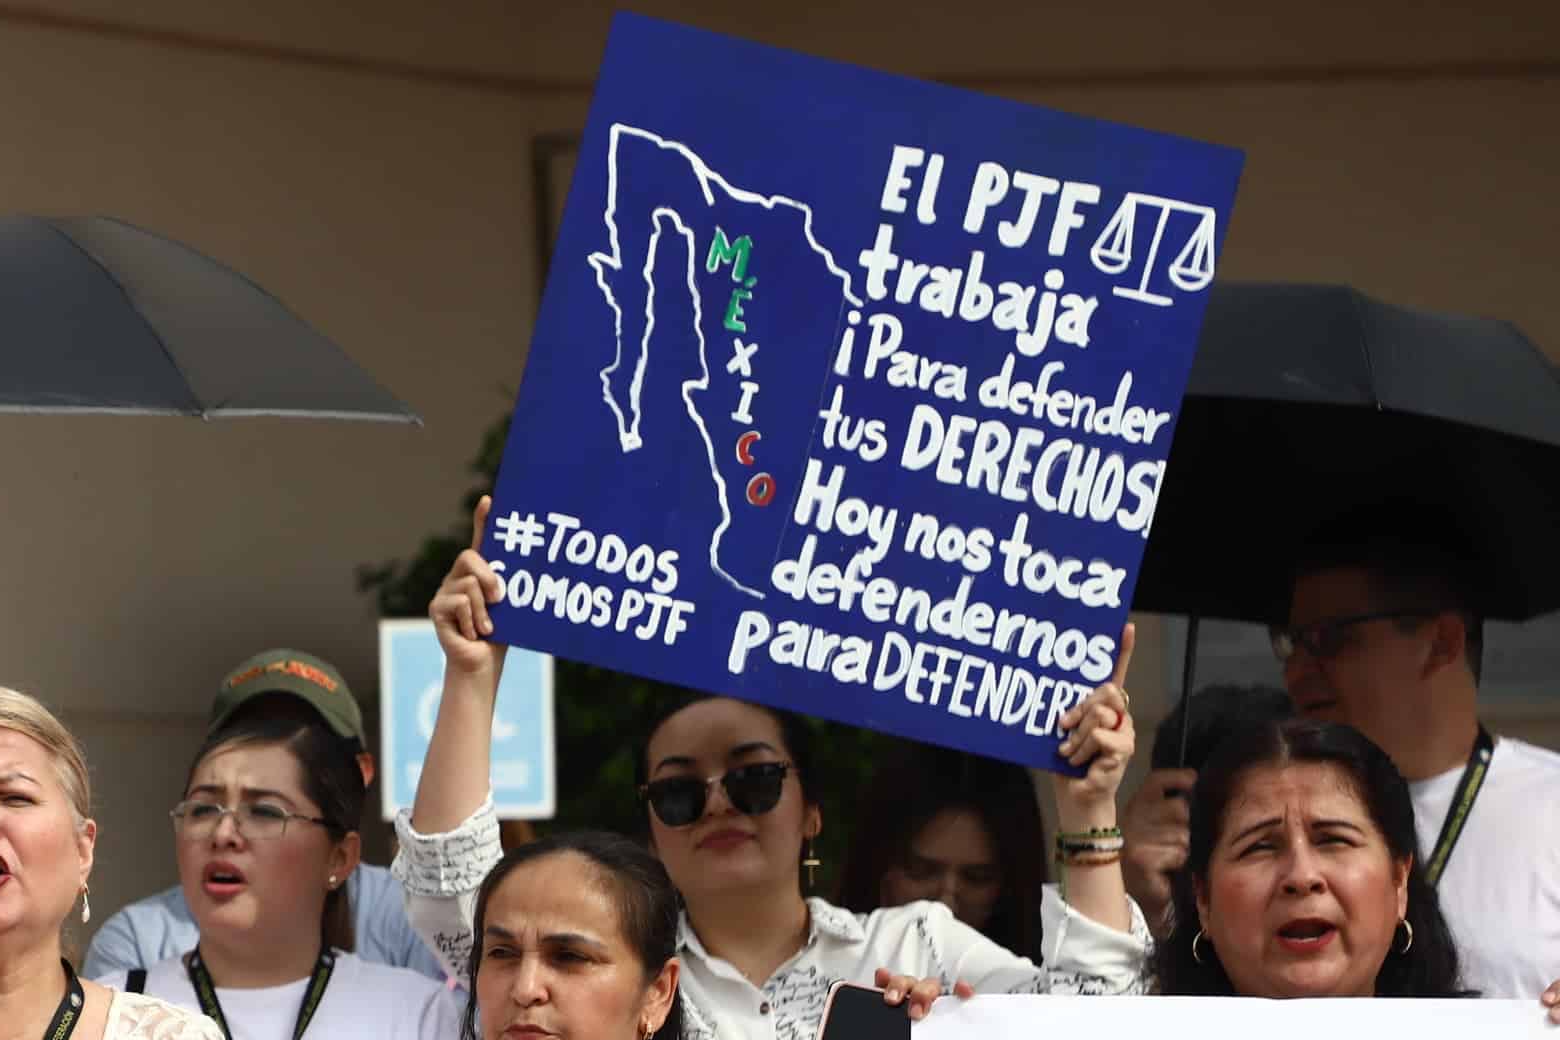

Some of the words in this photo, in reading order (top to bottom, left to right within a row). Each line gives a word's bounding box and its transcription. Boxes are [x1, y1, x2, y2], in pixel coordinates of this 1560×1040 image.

[880, 145, 944, 223] El
[963, 161, 1101, 257] PJF
[858, 224, 1099, 356] trabaja
[819, 384, 888, 461] tus
[978, 352, 1171, 445] defender
[493, 510, 679, 594] #TODOS
[793, 458, 898, 565] Hoy
[903, 516, 993, 573] nos
[999, 512, 1127, 608] toca
[771, 537, 1116, 682] defendernos
[728, 611, 872, 685] para
[872, 631, 1095, 738] DEFENDERT
